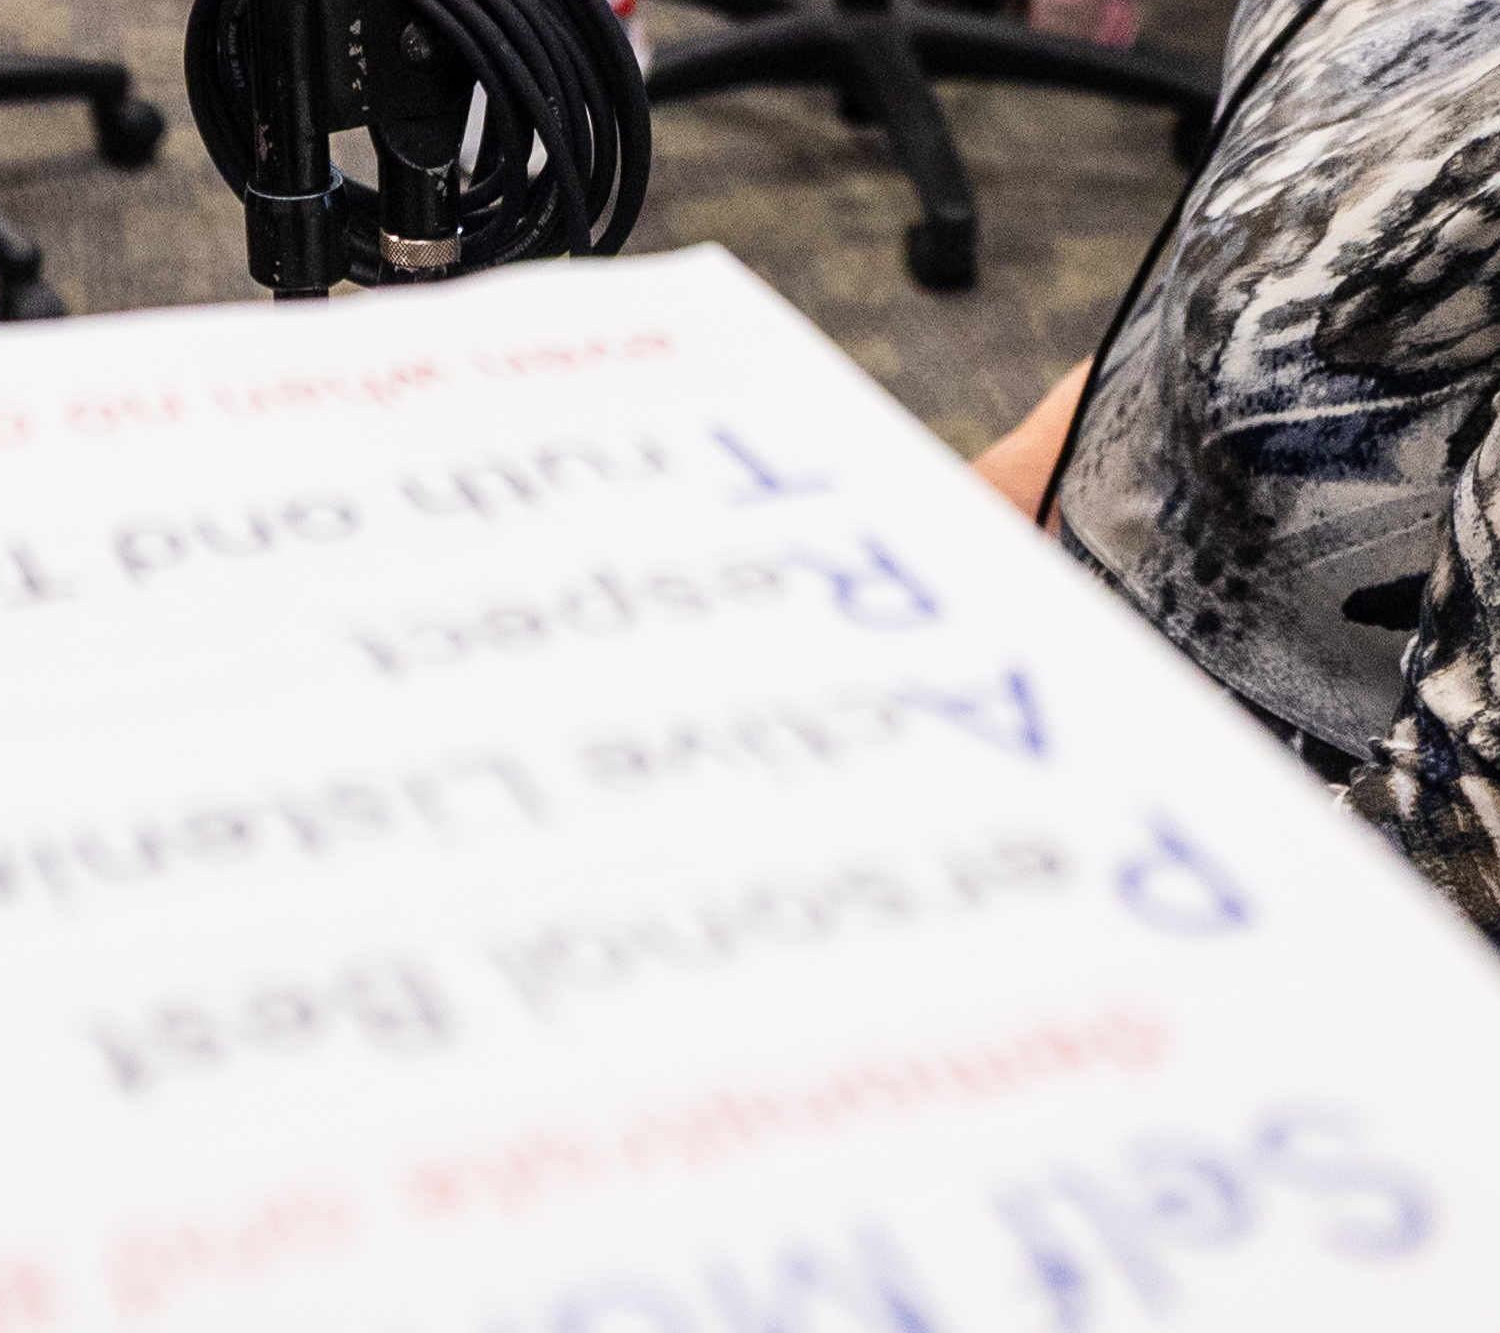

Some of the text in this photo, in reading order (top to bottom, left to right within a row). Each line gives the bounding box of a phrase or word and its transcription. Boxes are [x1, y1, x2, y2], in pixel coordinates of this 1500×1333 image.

[60, 390, 187, 437] no
[470, 330, 678, 381] even
[395, 425, 840, 525] Truth
[112, 493, 365, 588] and
[345, 533, 950, 685] Respect
[580, 661, 1055, 795] Active
[80, 808, 1265, 1103] Personal Best
[992, 1101, 1440, 1333] Self
